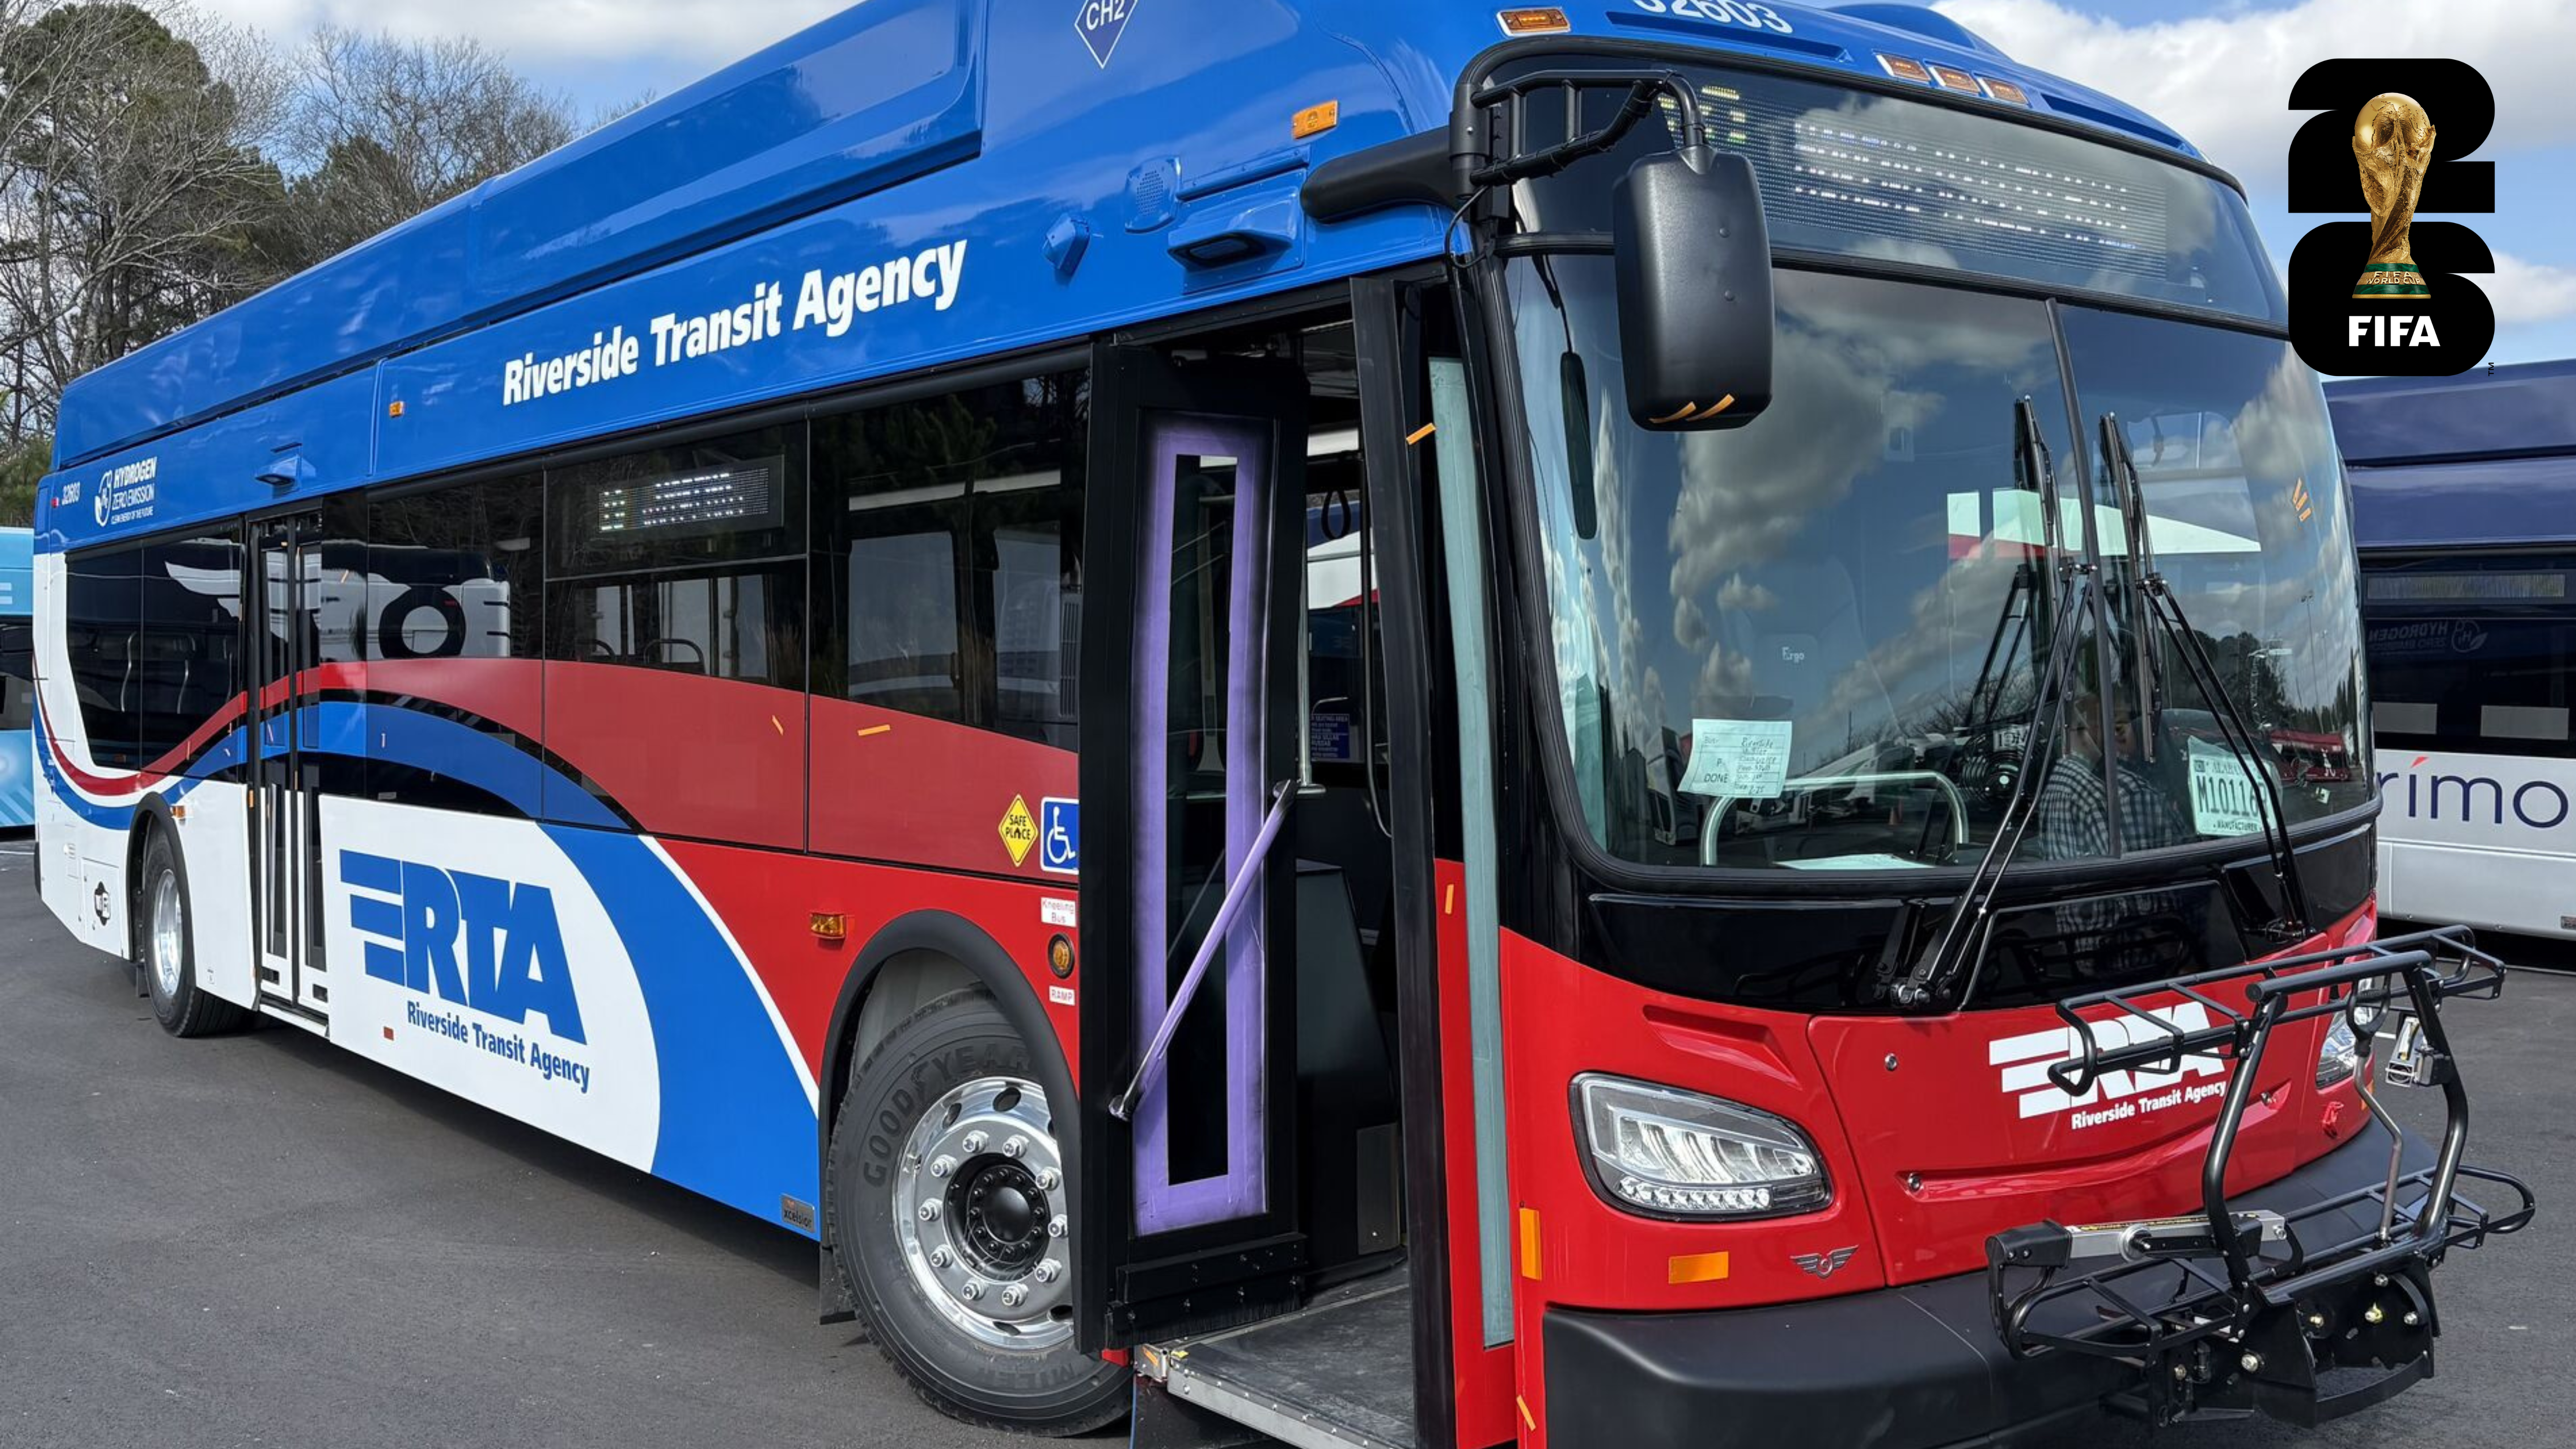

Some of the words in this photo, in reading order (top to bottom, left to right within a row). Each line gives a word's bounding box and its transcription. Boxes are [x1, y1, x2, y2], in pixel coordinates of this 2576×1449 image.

[1087, 0, 1125, 30] CH2
[503, 326, 639, 406] Riverside
[650, 281, 783, 367] Transit
[792, 240, 967, 337] Agency
[114, 457, 157, 489] HYDROGEN
[111, 491, 127, 510] ZERO
[1010, 815, 1026, 826] SAFE
[1042, 899, 1074, 915] Kneeling
[1051, 911, 1066, 924] Bus
[1051, 989, 1073, 1002] RAMP
[407, 1001, 468, 1043] Riverside
[472, 1022, 525, 1064] Transit
[530, 1042, 590, 1093] Agency
[2072, 1101, 2135, 1129] Riverside
[2138, 1089, 2182, 1114] Transit
[2185, 1080, 2226, 1103] Agency
